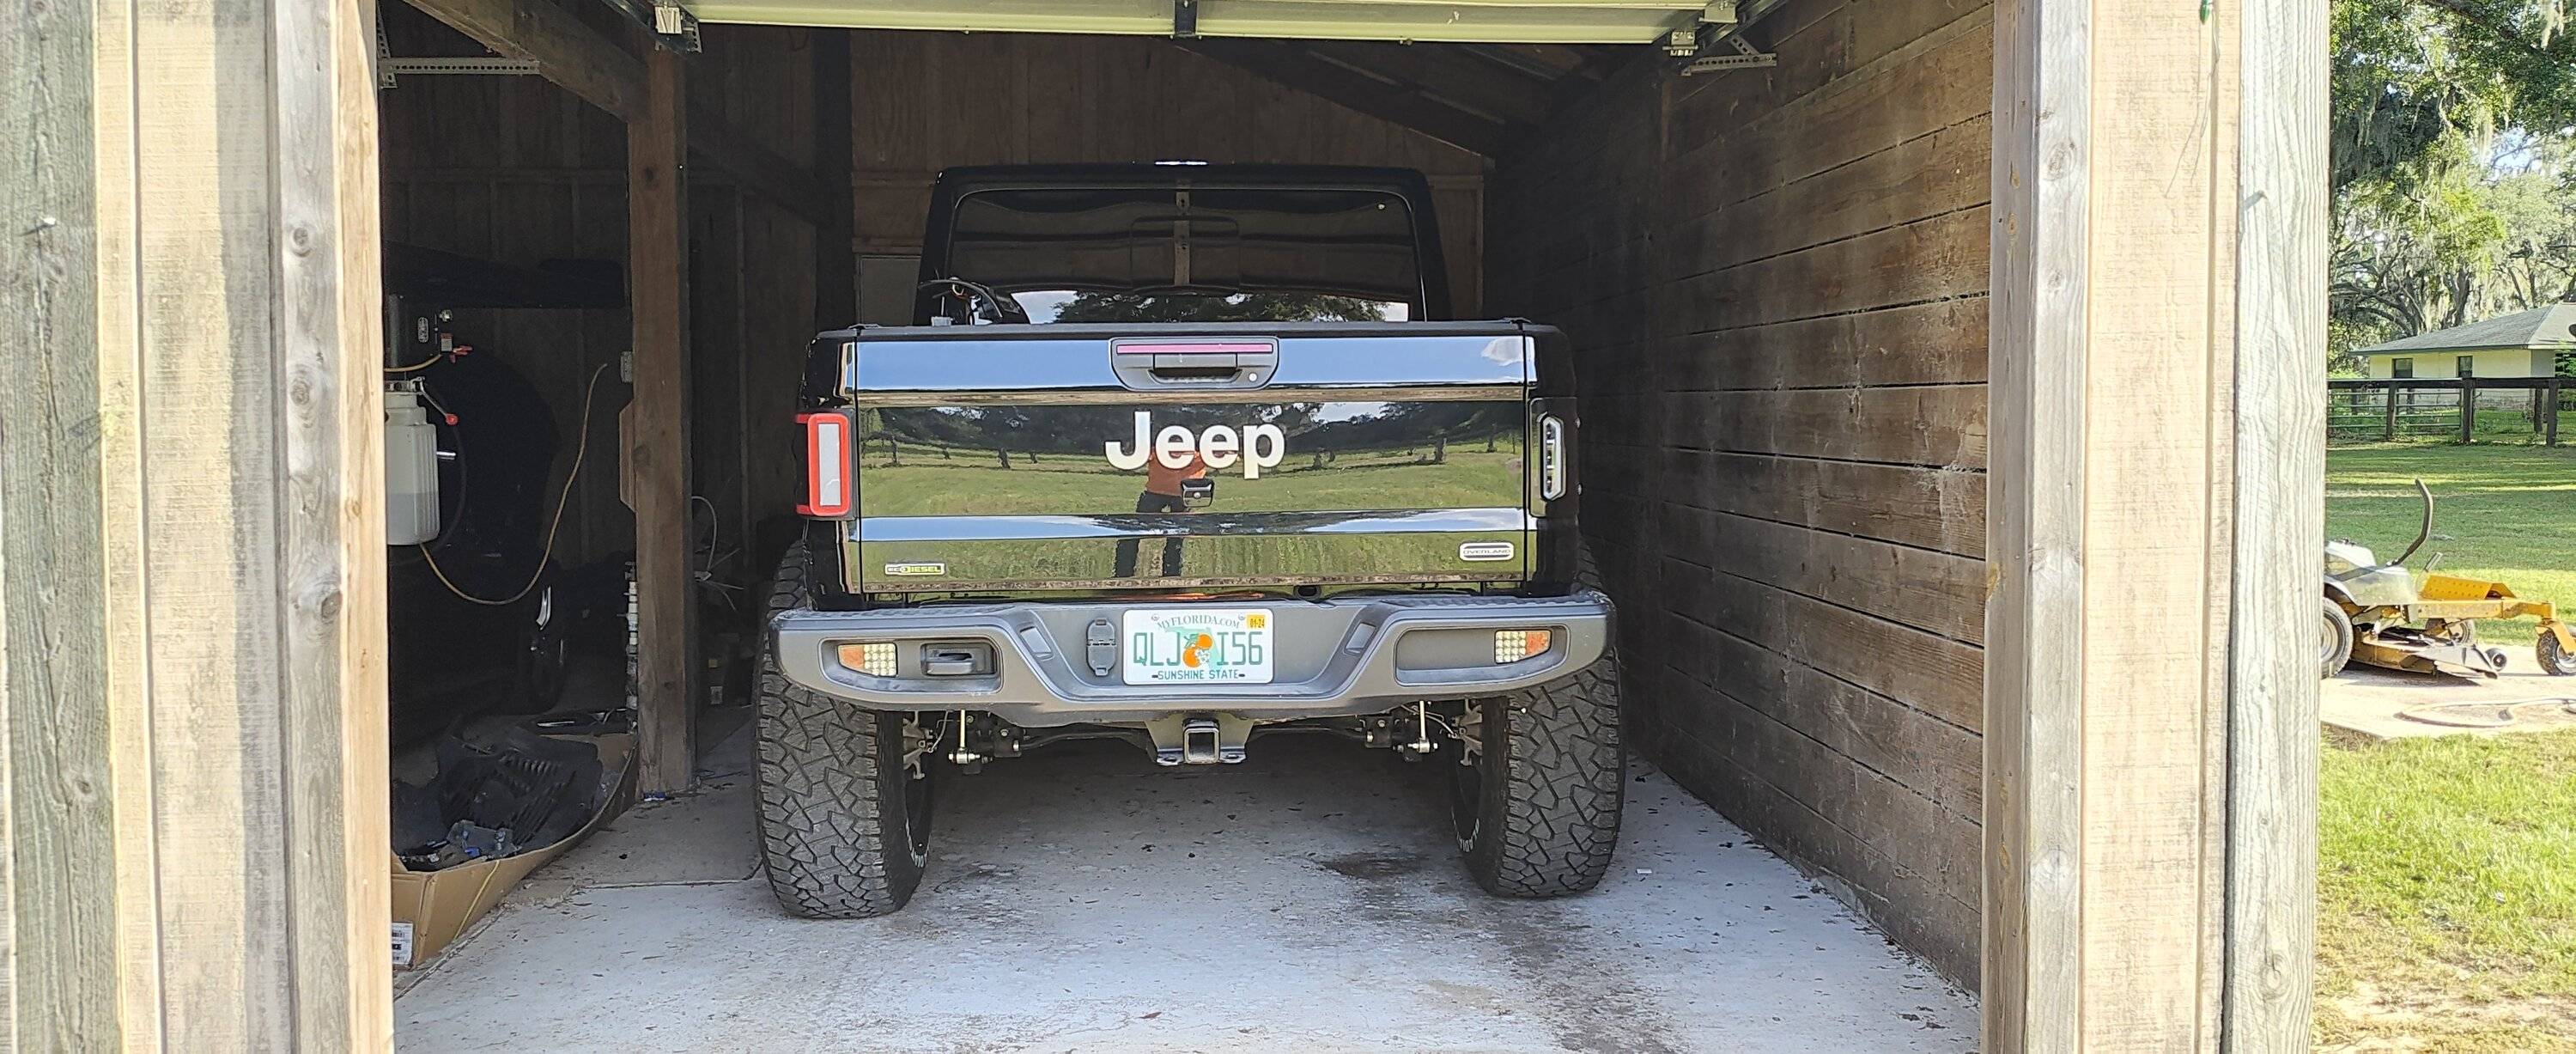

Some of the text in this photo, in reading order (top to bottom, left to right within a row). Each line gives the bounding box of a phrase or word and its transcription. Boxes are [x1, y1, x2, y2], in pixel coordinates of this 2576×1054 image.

[1104, 411, 1285, 479] Jeep
[1157, 614, 1240, 629] MYFLORIDA.COM
[1133, 631, 1263, 667] QLJ I56
[1157, 669, 1238, 680] SUNSHINE STATE
